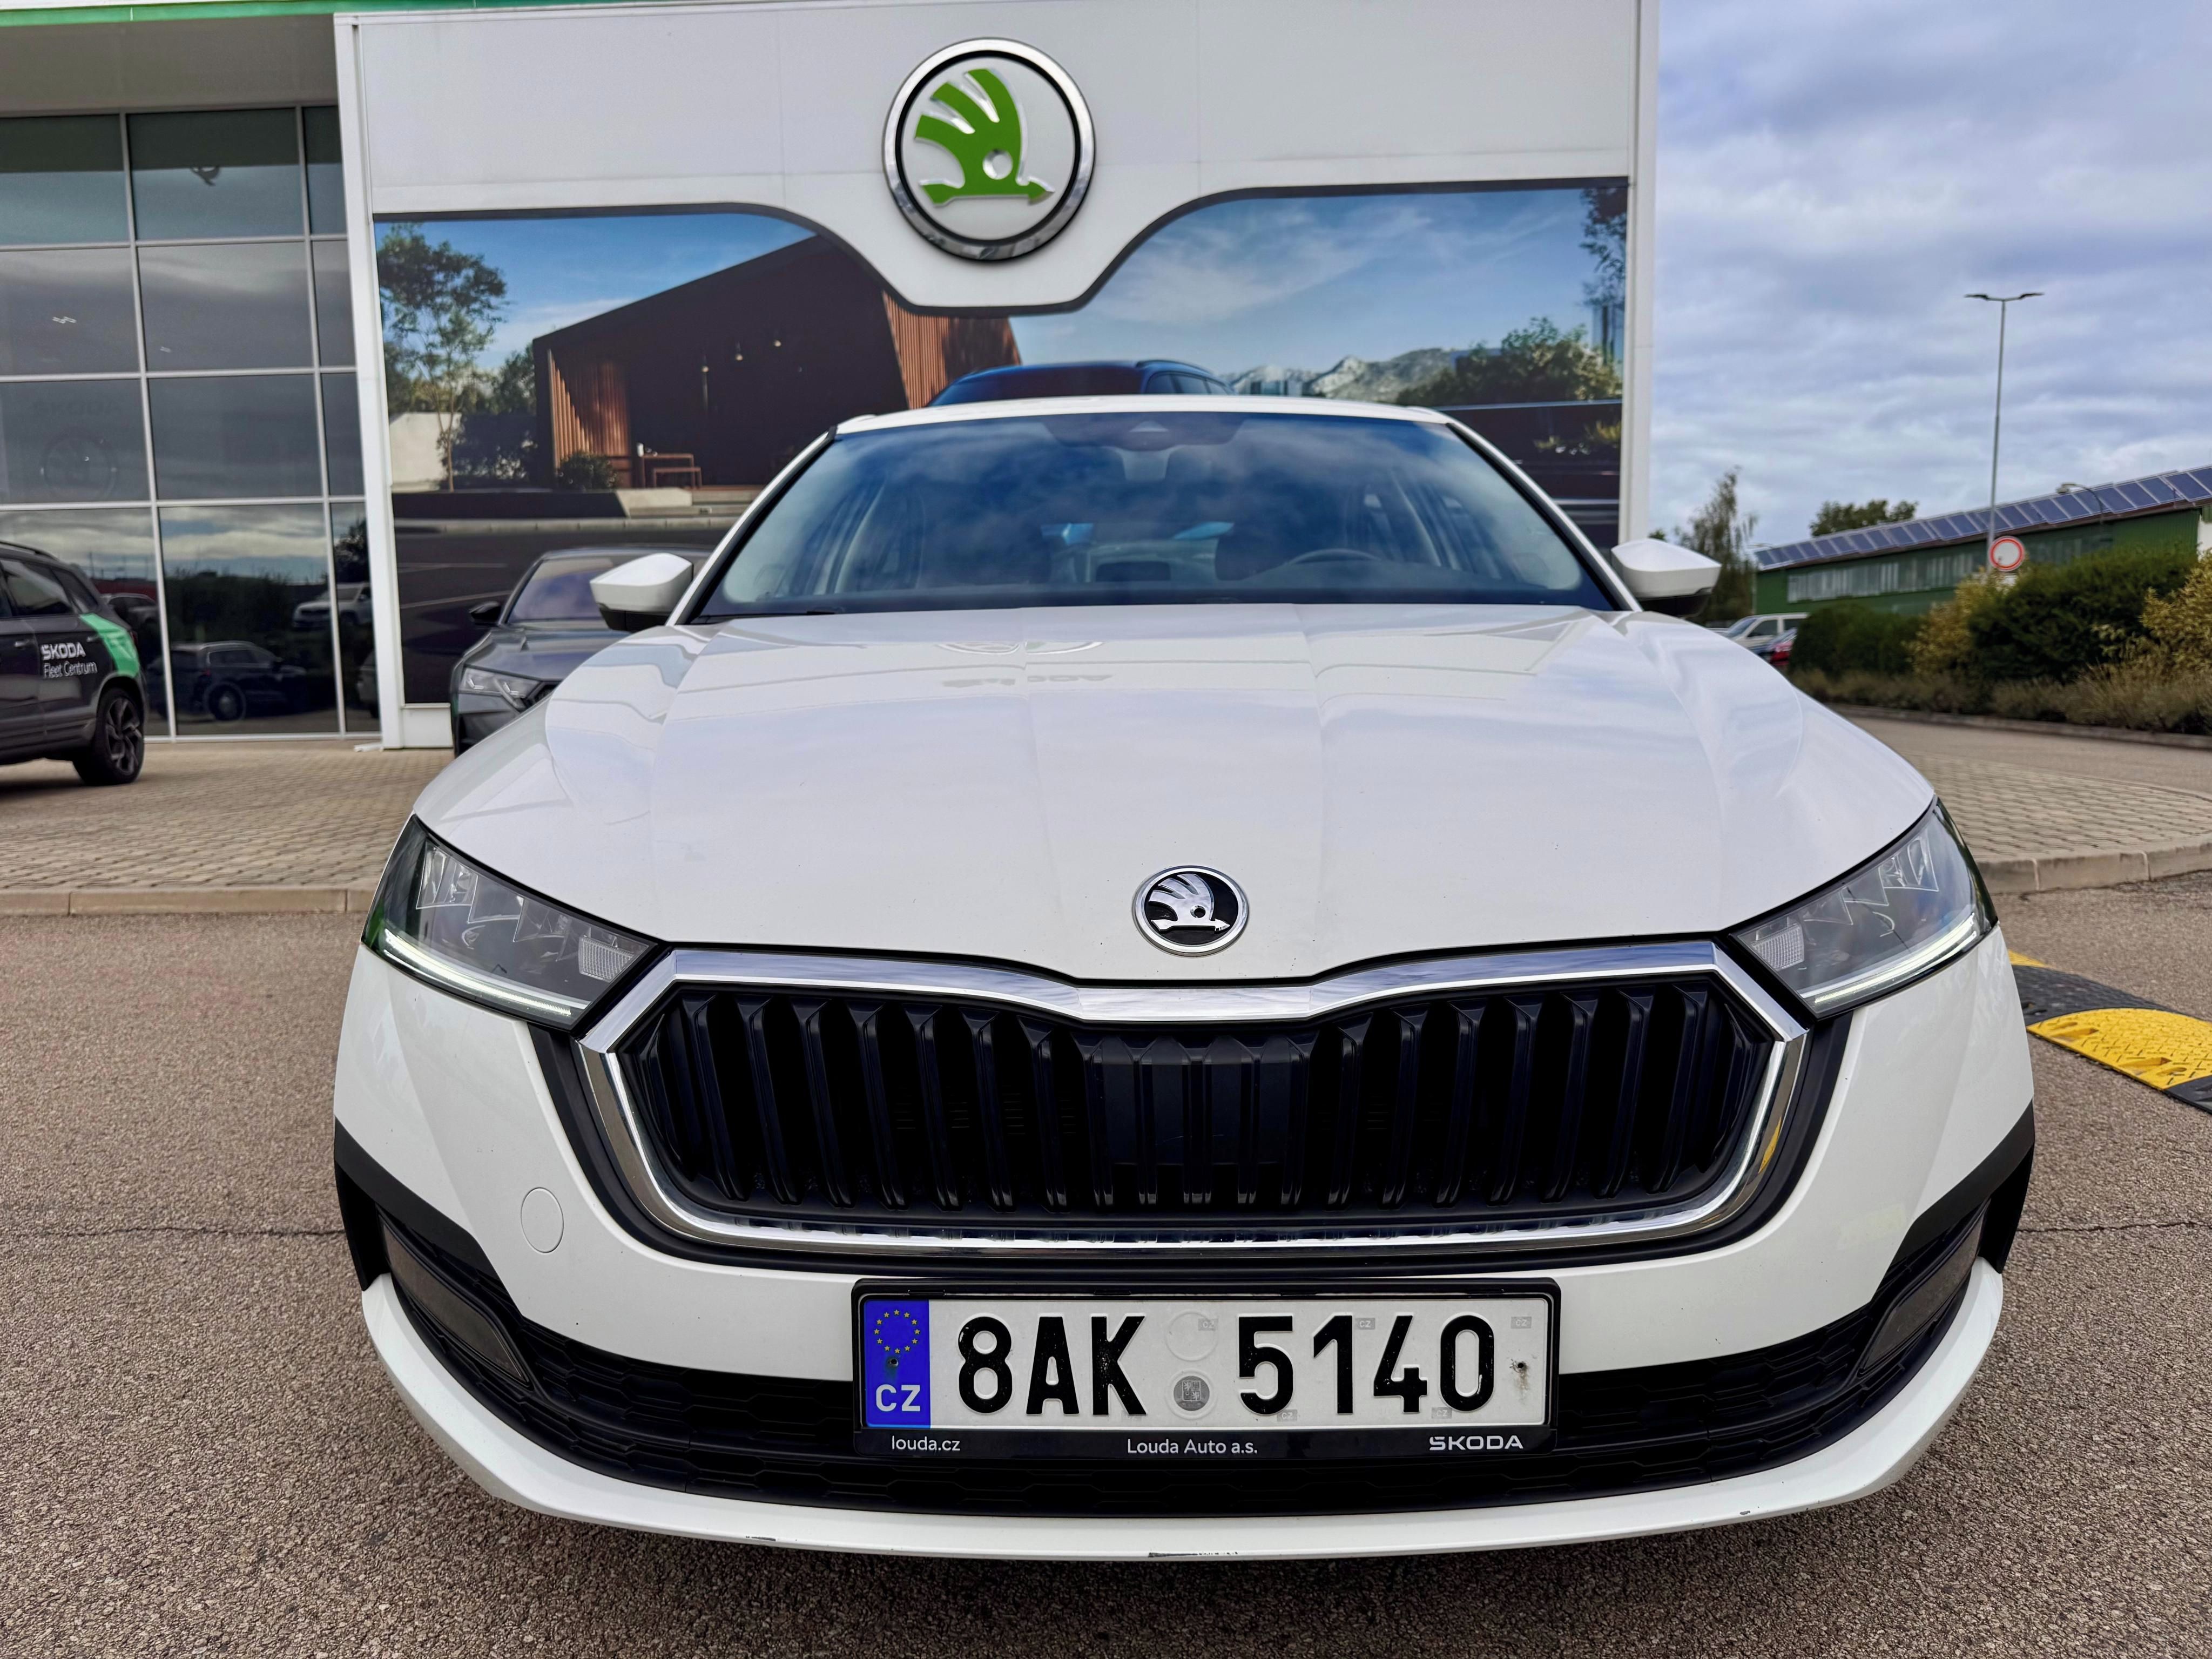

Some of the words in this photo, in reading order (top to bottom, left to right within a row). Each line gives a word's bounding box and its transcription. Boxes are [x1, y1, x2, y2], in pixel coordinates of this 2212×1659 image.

[44, 663, 63, 678] Fleet
[64, 660, 98, 676] Centrum
[957, 1316, 1147, 1415] 8AK
[1238, 1314, 1494, 1415] 5140
[875, 1384, 921, 1412] CZ
[892, 1435, 960, 1451] louda.cz
[1128, 1439, 1178, 1454] Louda
[1184, 1439, 1226, 1454] Auto
[1231, 1442, 1257, 1454] a.s.
